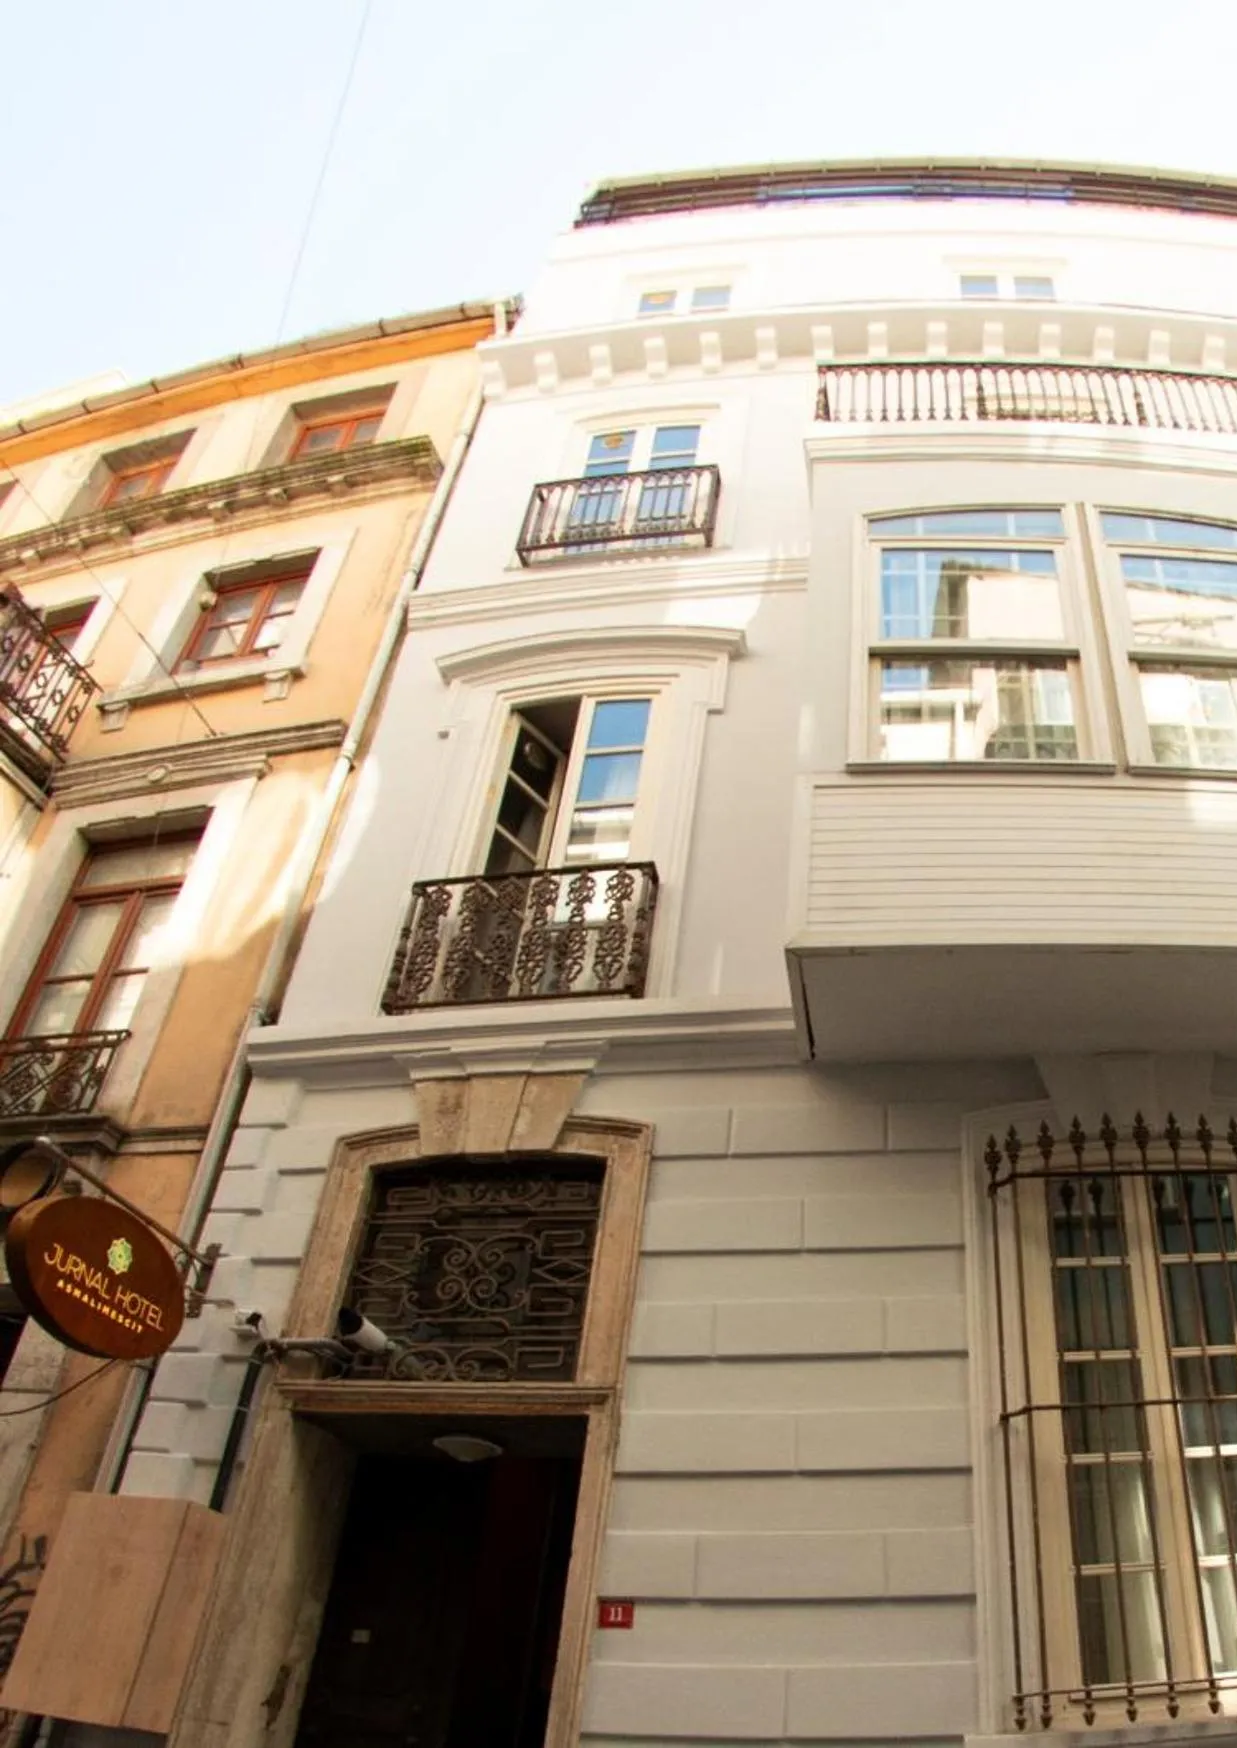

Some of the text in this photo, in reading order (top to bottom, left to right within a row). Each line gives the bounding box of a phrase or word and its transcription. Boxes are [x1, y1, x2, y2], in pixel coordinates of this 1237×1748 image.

[43, 1242, 164, 1332] JURNAL HOTEL
[608, 1606, 623, 1622] 11
